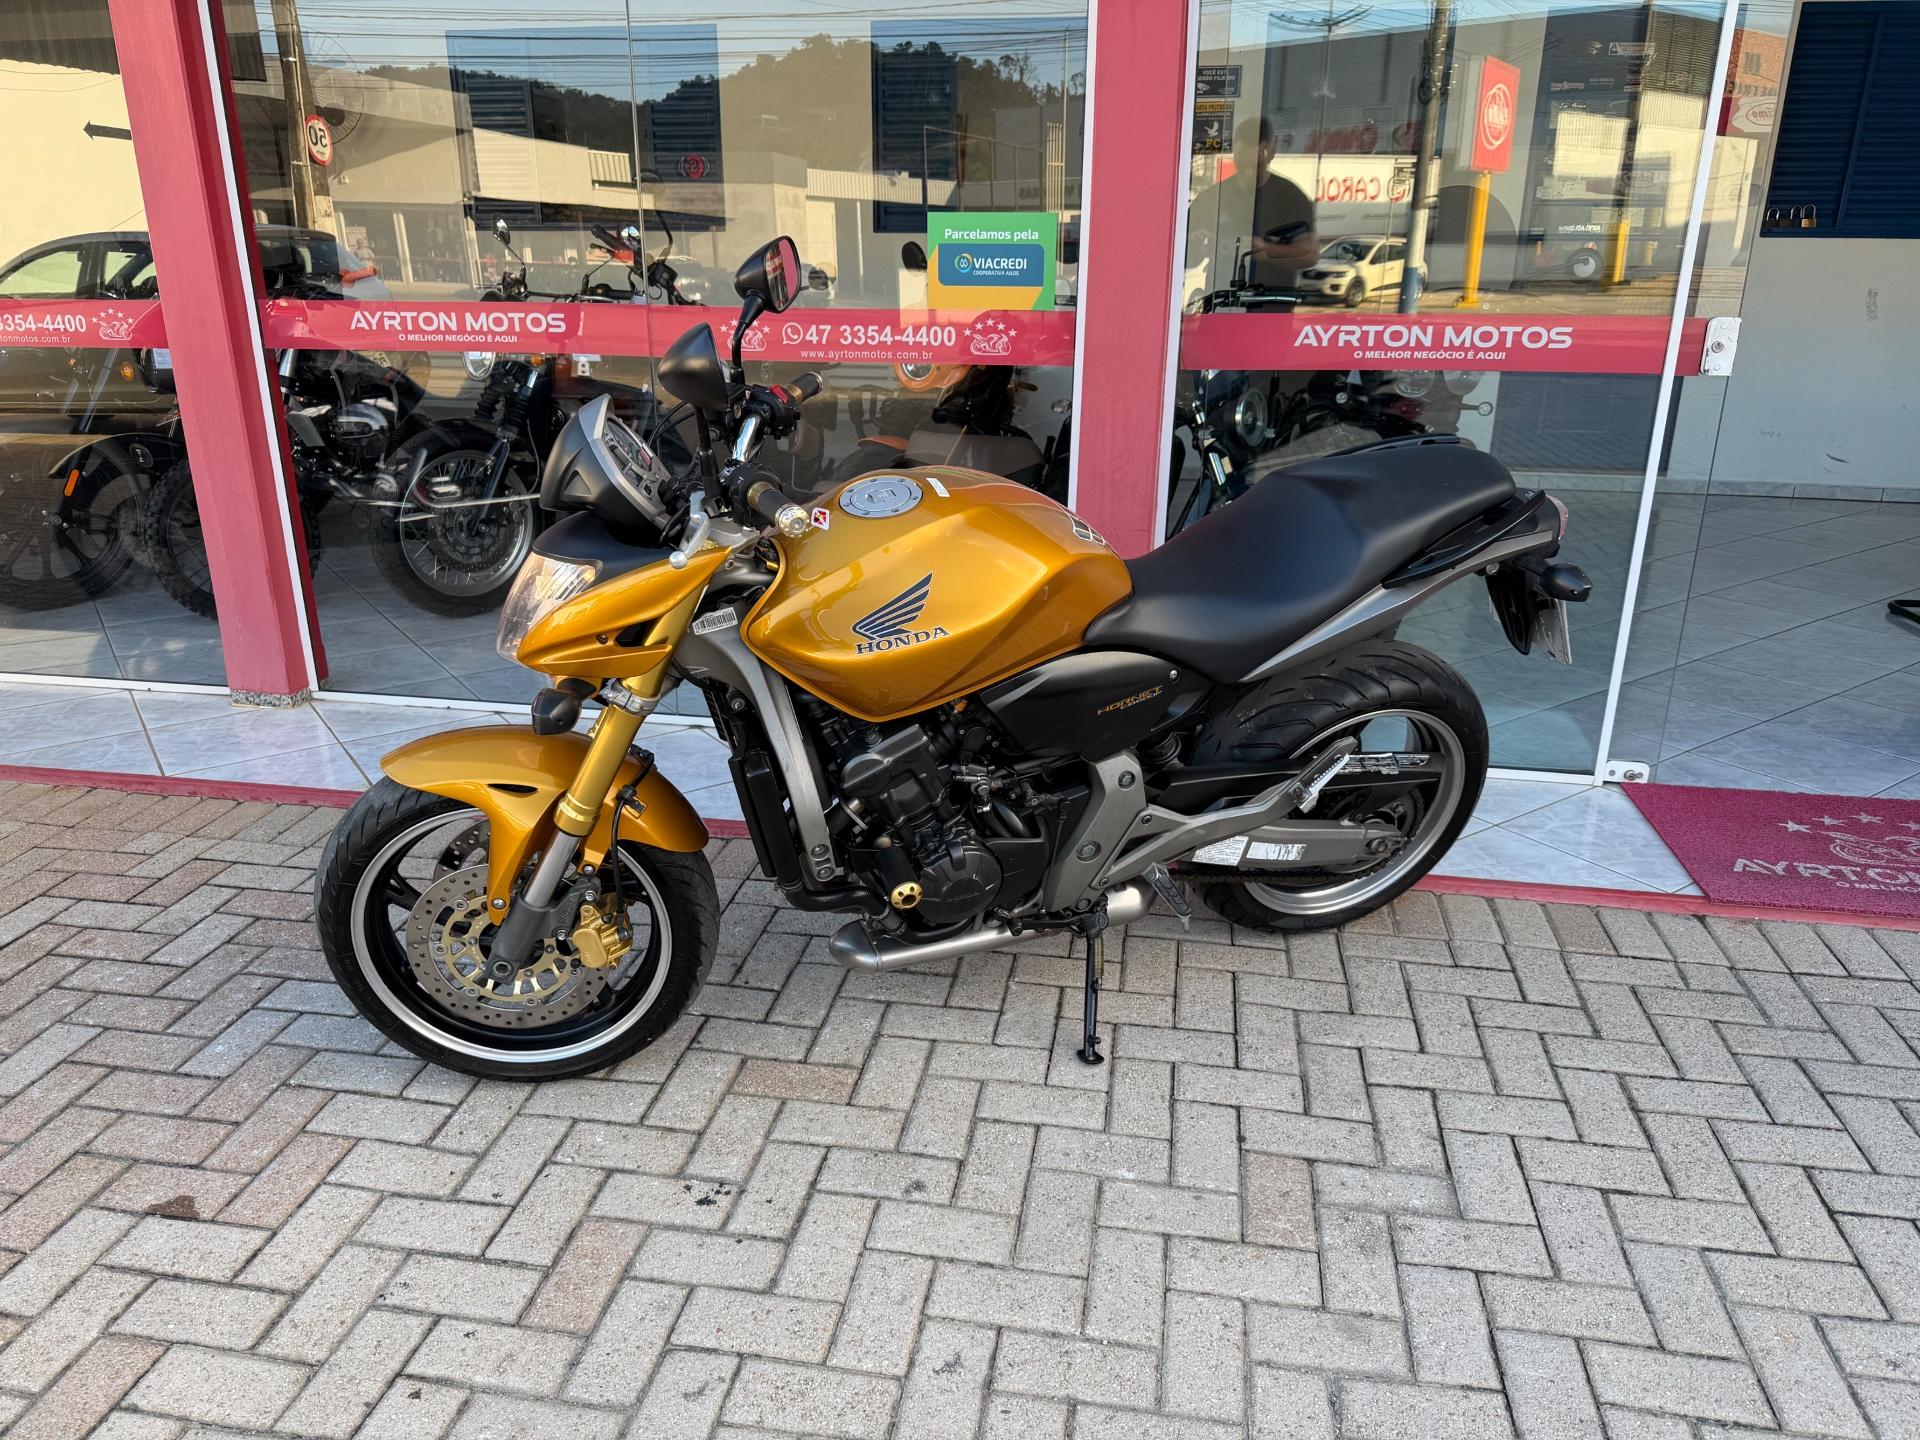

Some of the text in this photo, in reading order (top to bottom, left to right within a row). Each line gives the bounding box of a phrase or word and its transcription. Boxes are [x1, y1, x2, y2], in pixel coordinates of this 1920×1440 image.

[944, 228, 1039, 242] Parcelamos pela
[973, 258, 1028, 270] VIACREDI
[350, 311, 567, 333] AYRTON MOTOS
[398, 332, 518, 343] O MELHOR NEGÓCIO É AQUI
[805, 324, 957, 347] 47 3354-4400
[1294, 325, 1574, 349] AYRTON MOTOS
[800, 349, 934, 361] www.ayrtonmotos.com.br
[1353, 348, 1507, 360] O MELHOR NEGÓCIO É AQUI
[855, 626, 950, 655] HONDA
[1853, 883, 1920, 893] MELHO
